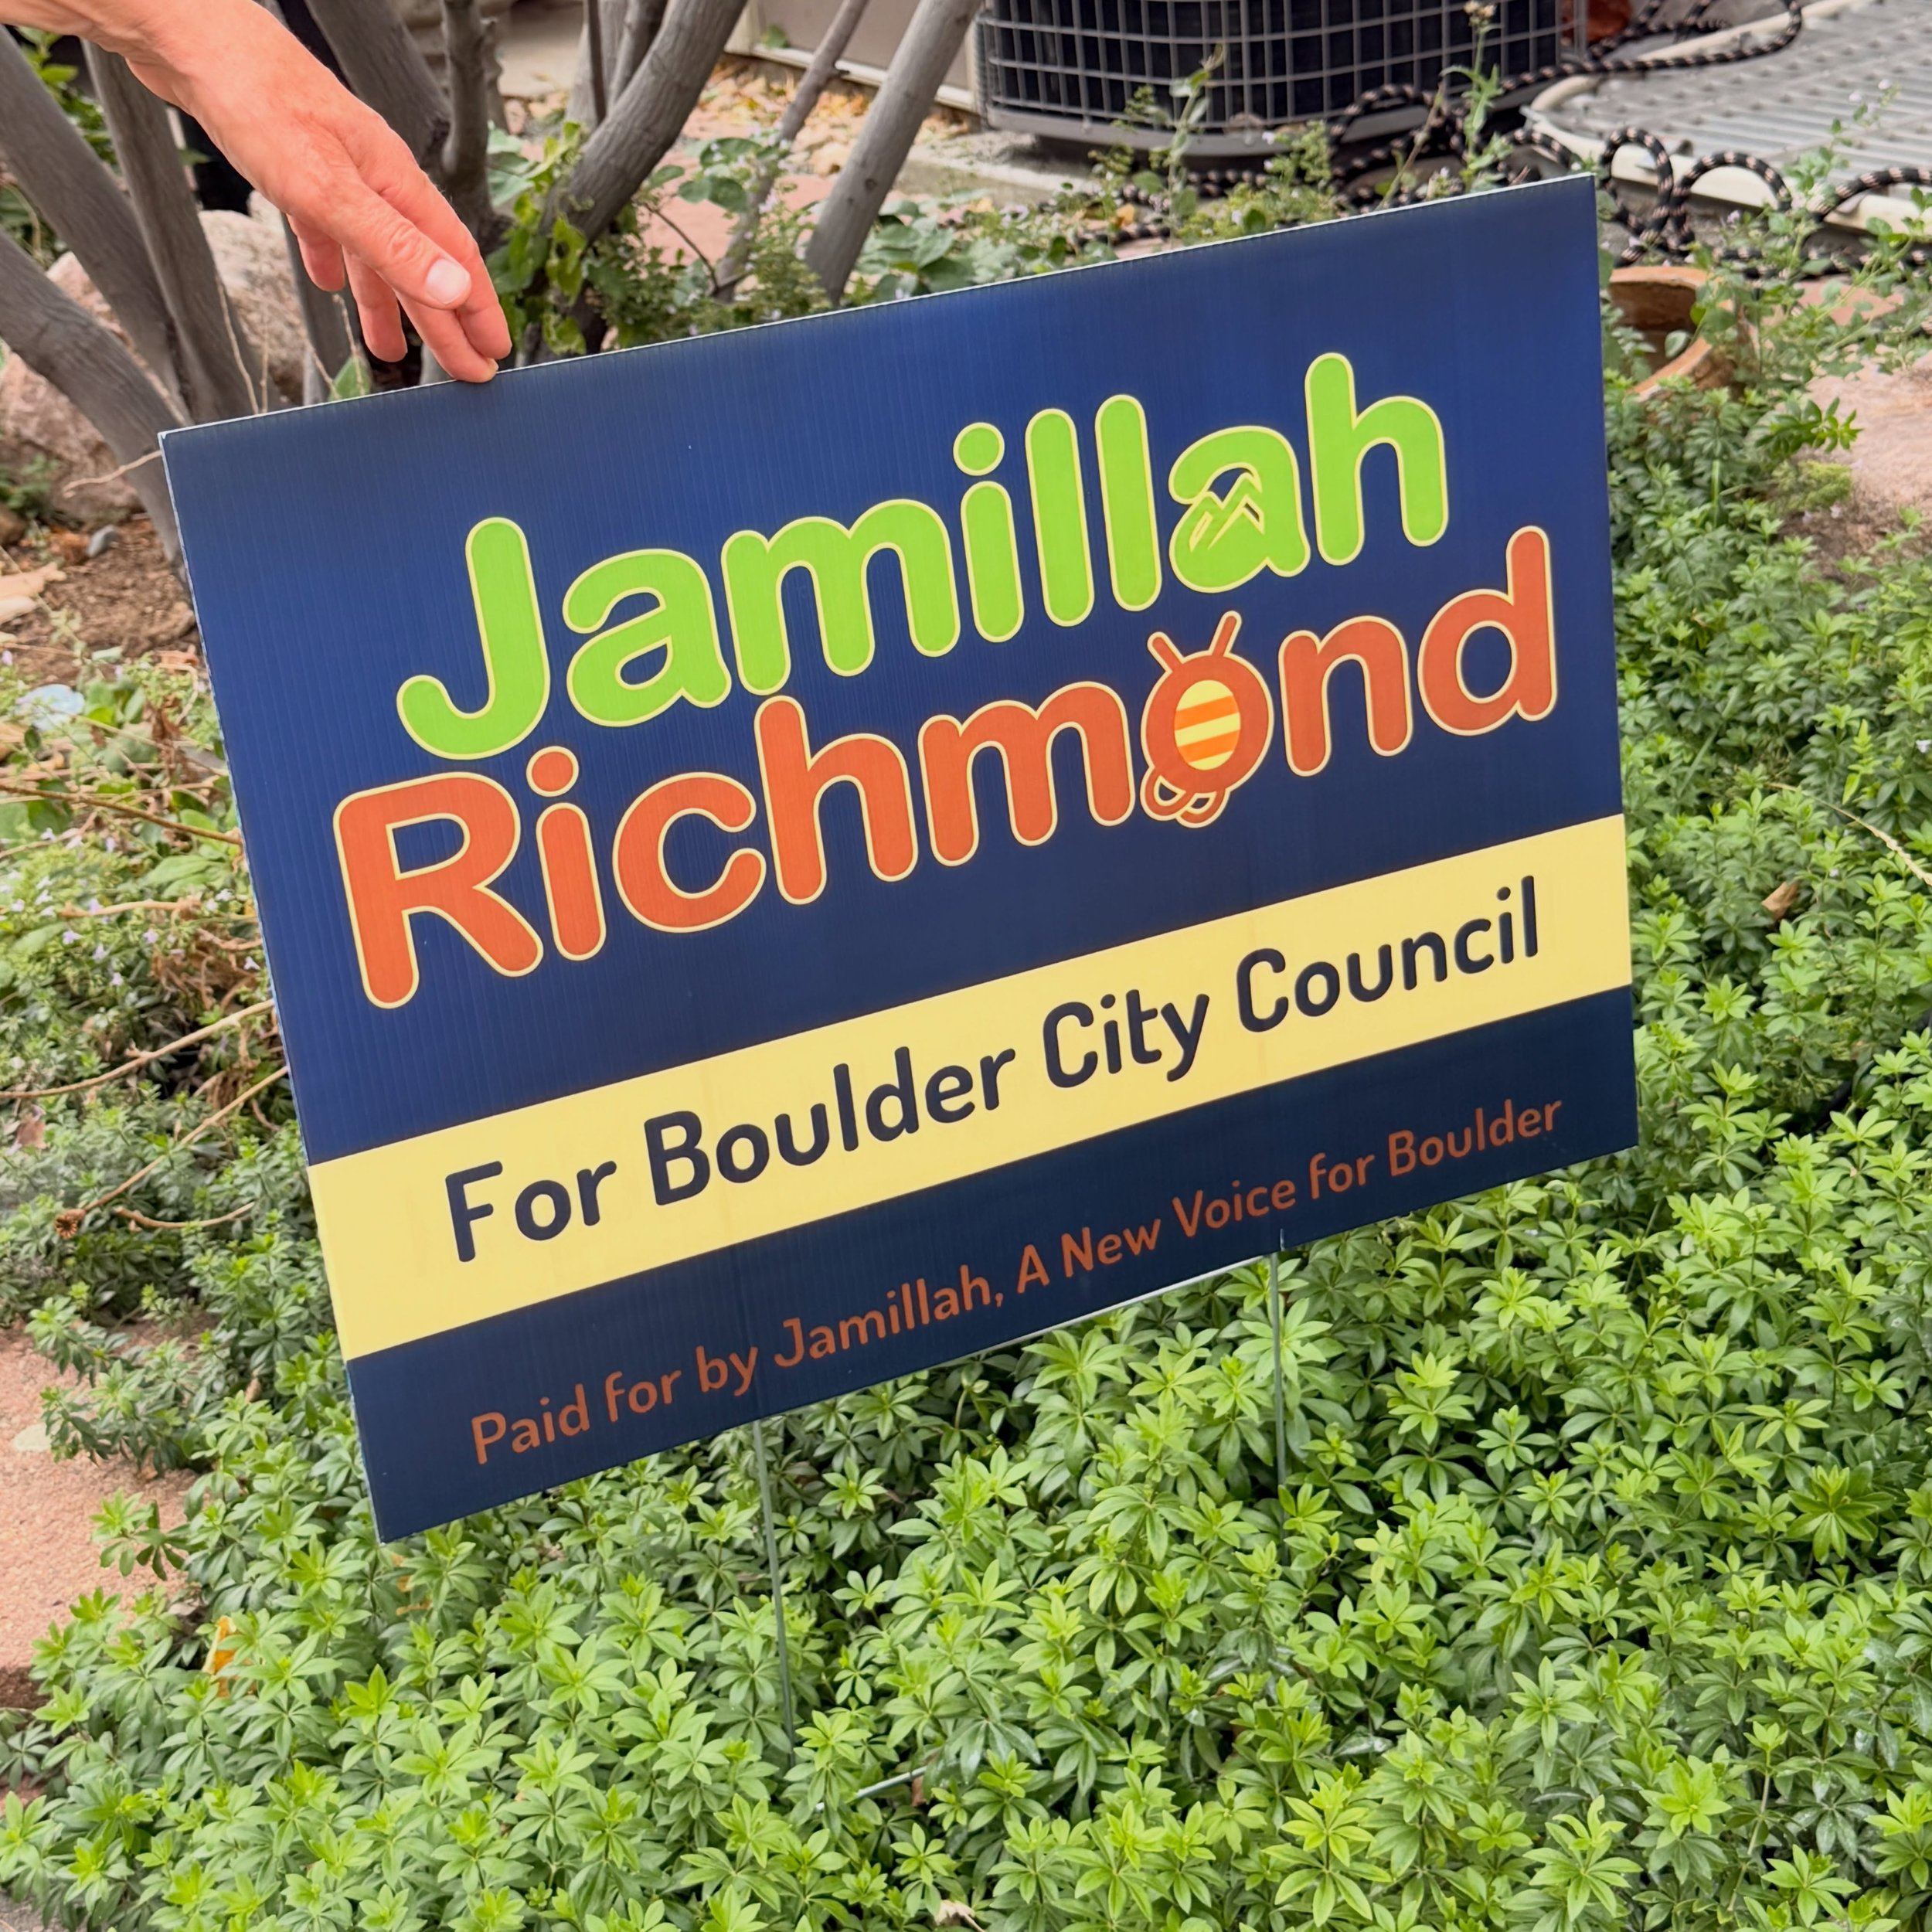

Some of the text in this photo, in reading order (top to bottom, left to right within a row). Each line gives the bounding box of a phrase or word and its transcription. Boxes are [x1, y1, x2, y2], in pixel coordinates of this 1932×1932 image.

[396, 352, 1450, 760] Jamillah
[332, 526, 1559, 1011] Richmond
[444, 874, 1540, 1263] For Boulder City Council
[469, 1097, 1563, 1466] Paid for by Jamillah, A New Voice for Boulder
